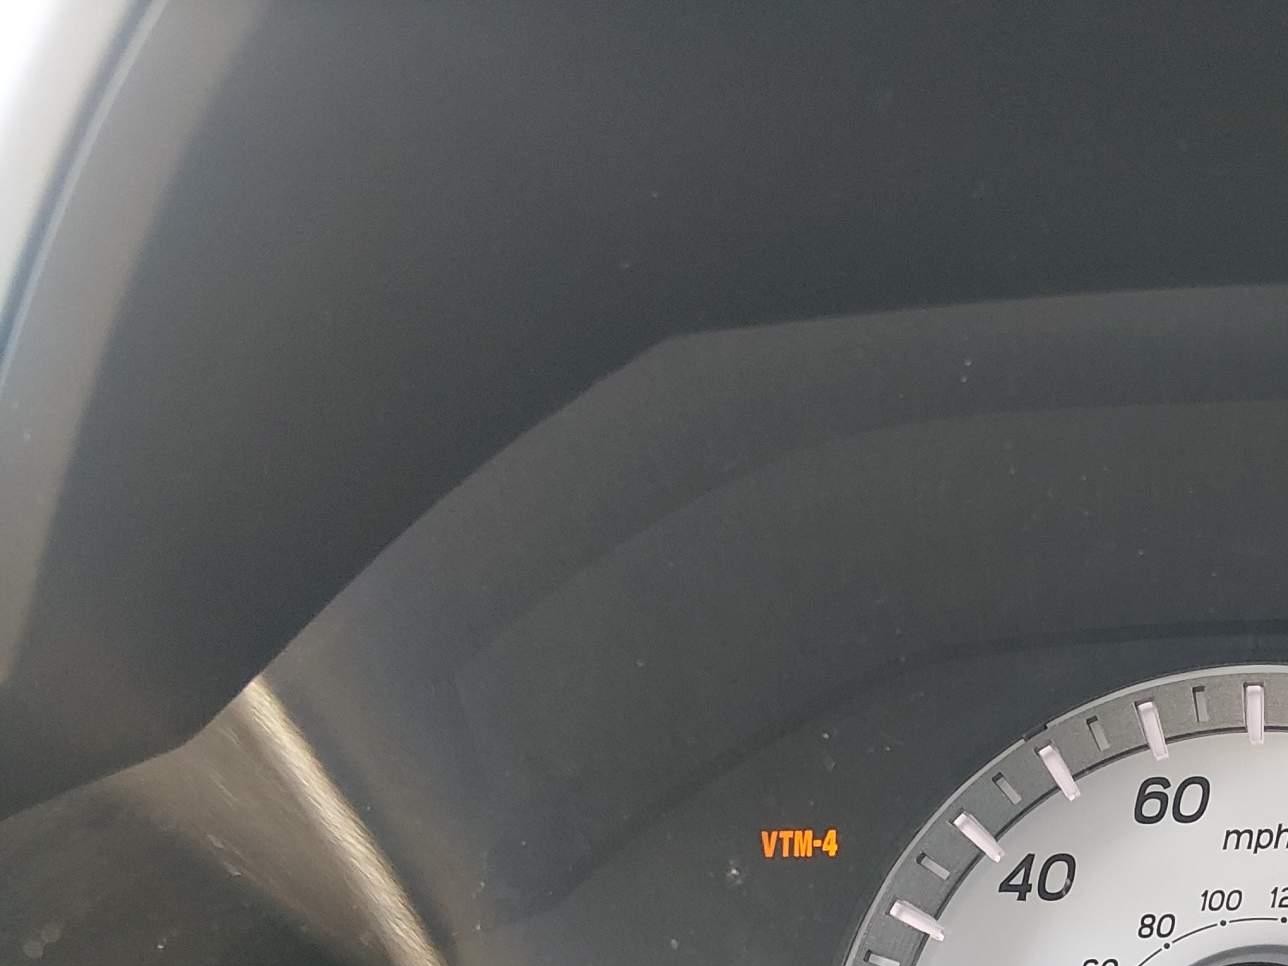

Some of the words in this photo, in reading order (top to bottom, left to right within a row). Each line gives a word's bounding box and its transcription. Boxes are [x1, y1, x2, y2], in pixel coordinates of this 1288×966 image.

[1134, 776, 1210, 824] 60
[761, 829, 838, 858] VTM-4
[999, 853, 1076, 901] 40
[1200, 889, 1242, 911] 100
[1138, 914, 1176, 938] 80
